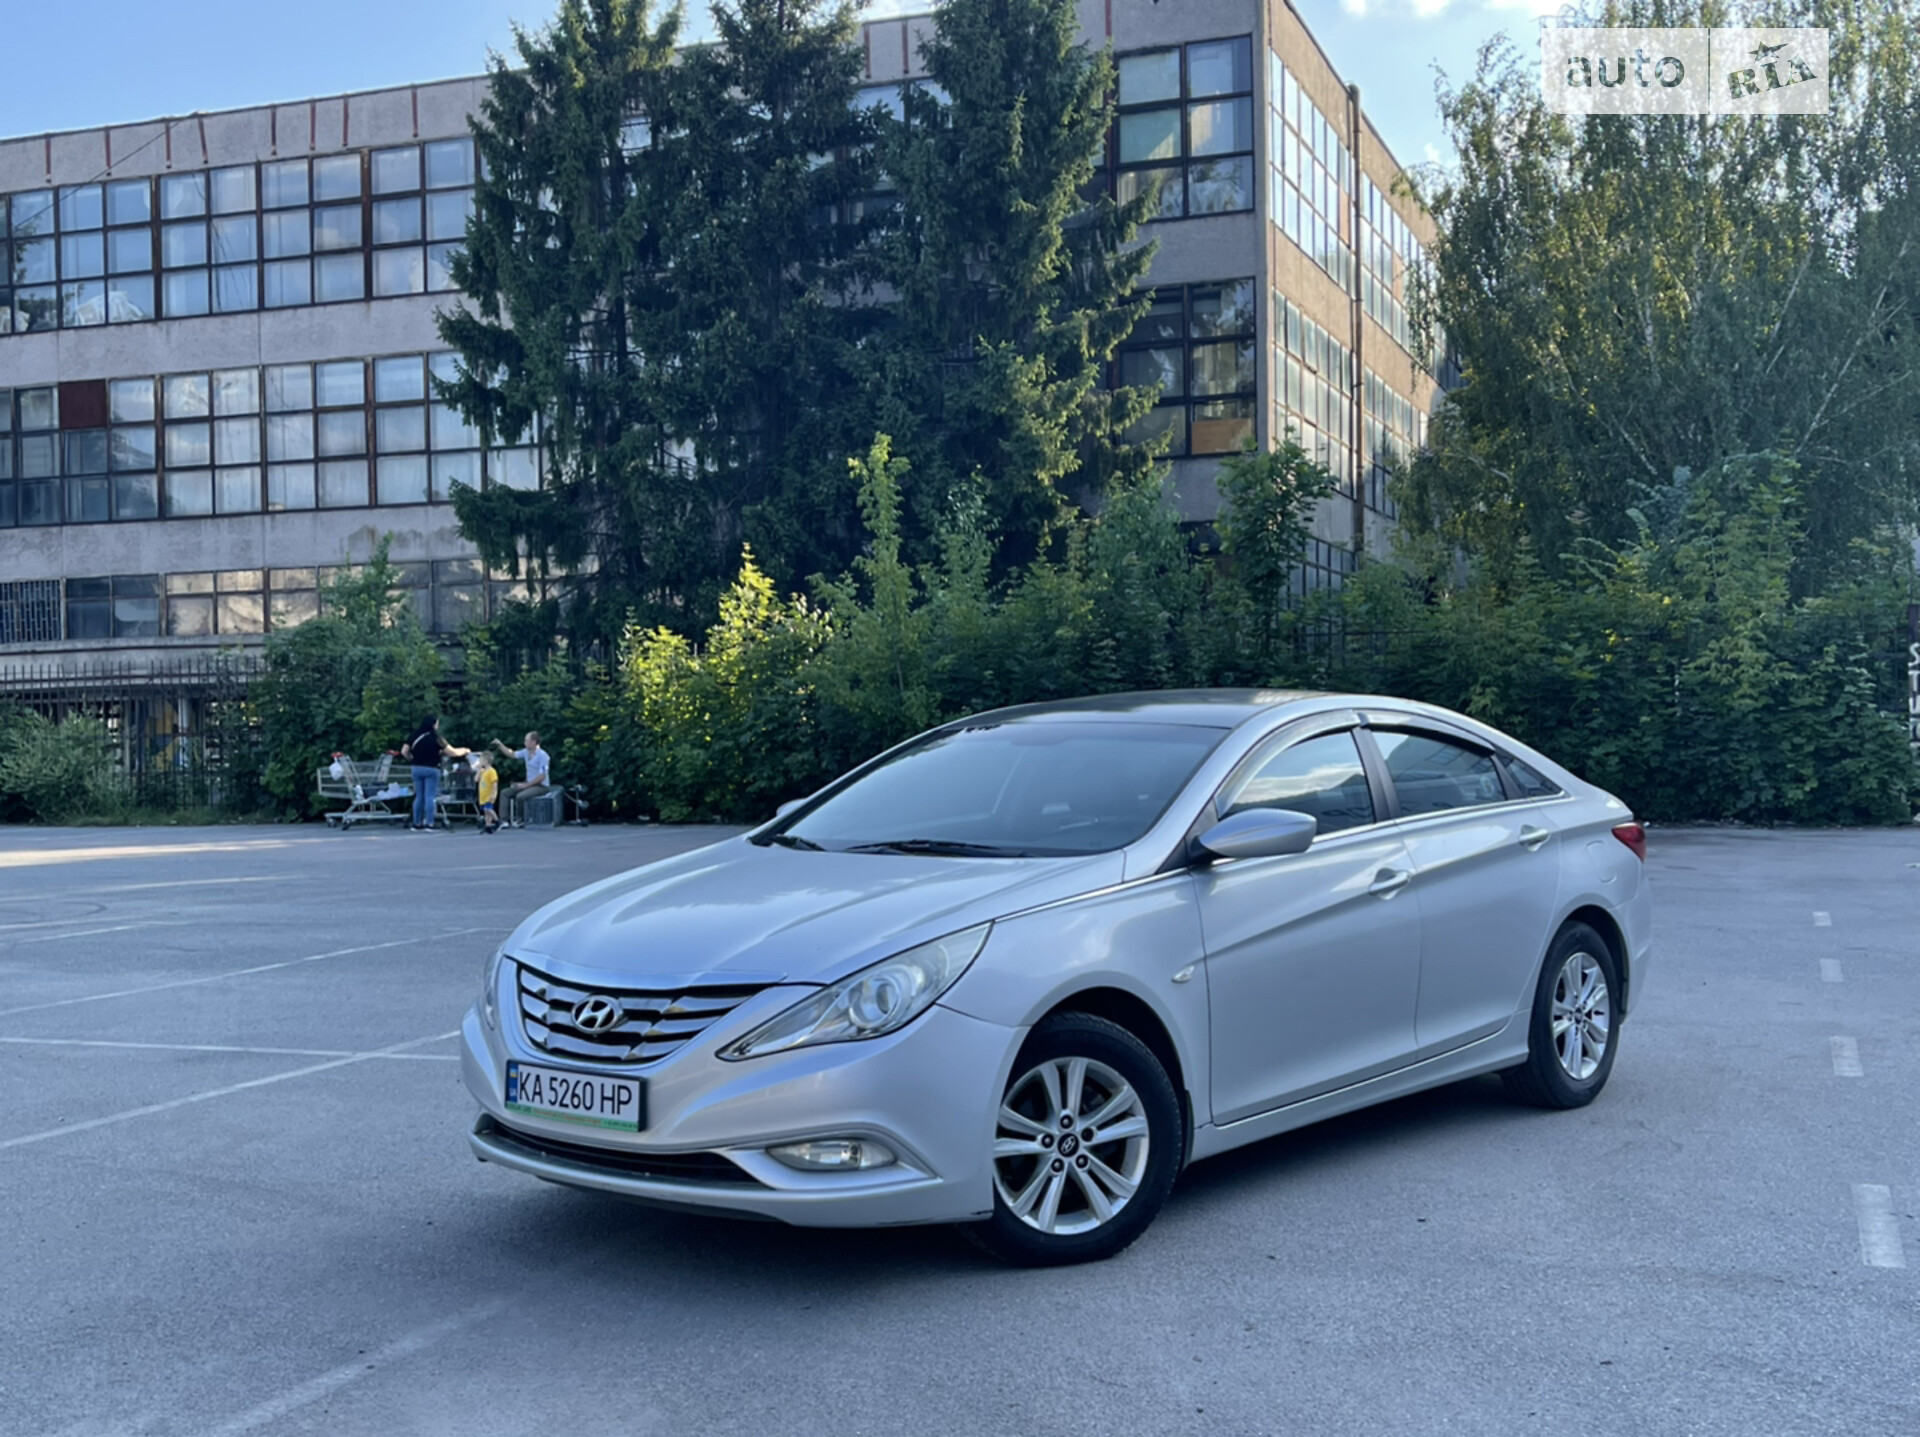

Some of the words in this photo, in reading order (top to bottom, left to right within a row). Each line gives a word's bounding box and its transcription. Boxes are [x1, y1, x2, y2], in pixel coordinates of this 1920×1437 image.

[519, 1072, 543, 1104] KA
[548, 1076, 594, 1111] 5260
[600, 1083, 632, 1115] HP
